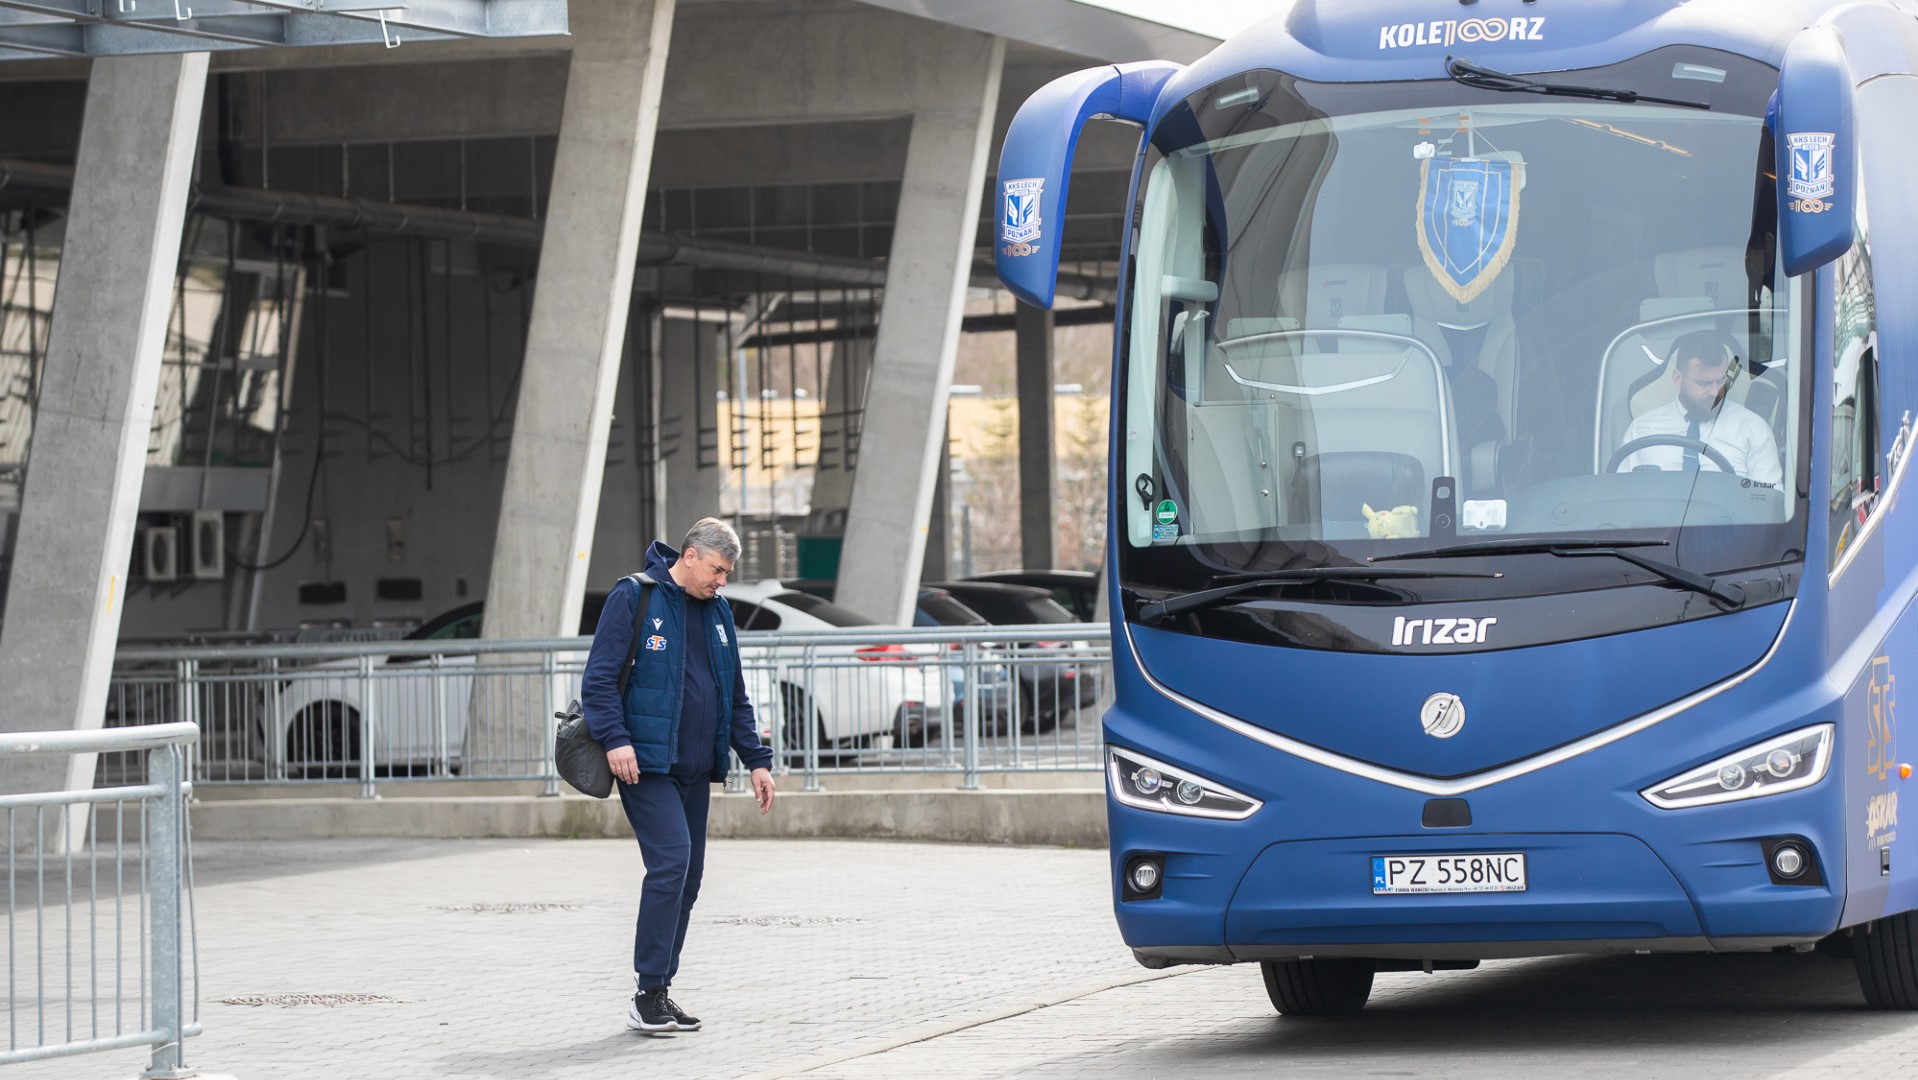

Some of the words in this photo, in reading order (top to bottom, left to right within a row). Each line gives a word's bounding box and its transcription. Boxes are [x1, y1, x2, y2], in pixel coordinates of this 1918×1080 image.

[1810, 135, 1828, 143] LECH
[1021, 181, 1037, 189] LECH
[1392, 616, 1497, 646] Irizar
[646, 635, 667, 650] STS
[1388, 859, 1427, 886] PZ
[1437, 857, 1520, 885] 558NC
[1375, 876, 1385, 884] PL
